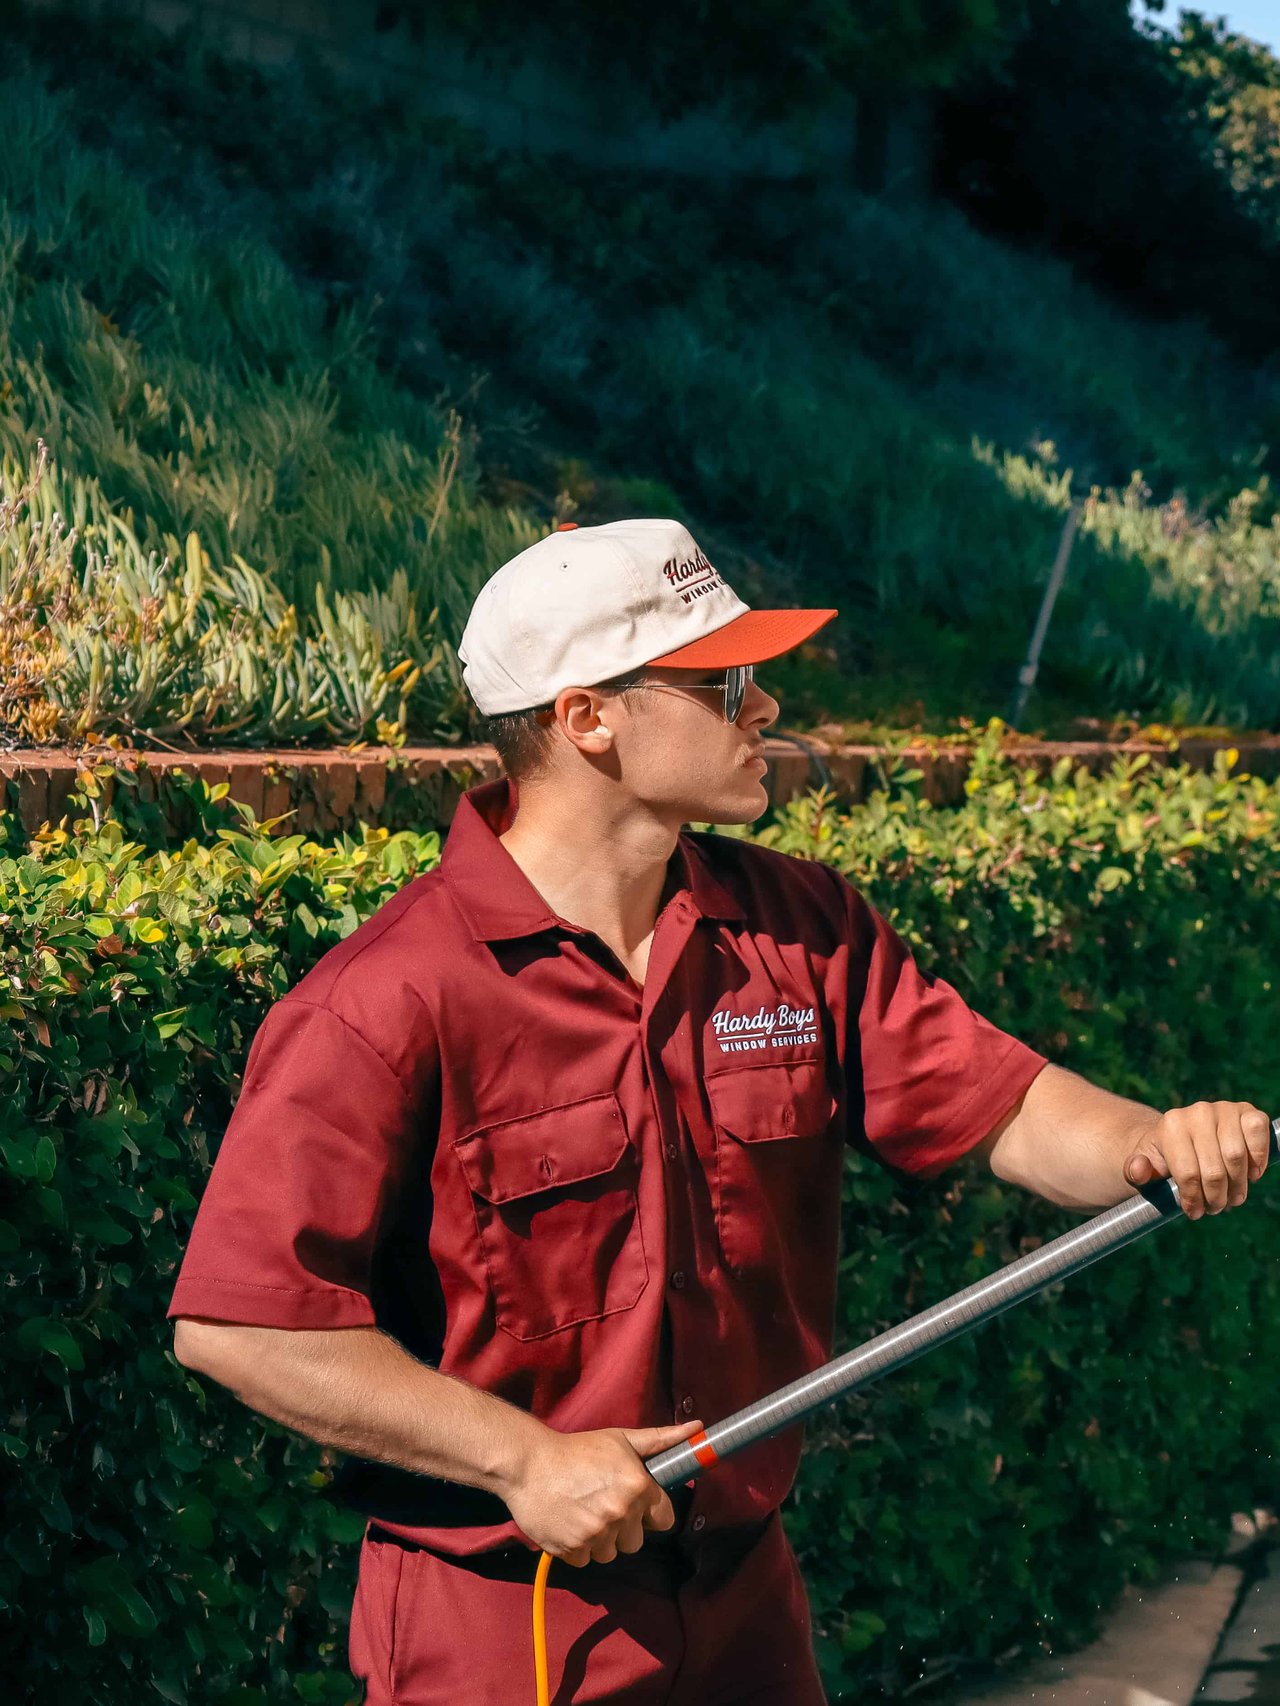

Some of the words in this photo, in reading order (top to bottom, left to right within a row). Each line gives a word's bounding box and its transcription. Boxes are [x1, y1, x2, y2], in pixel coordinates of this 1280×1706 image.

[663, 548, 713, 586] Hardy
[712, 1007, 777, 1034] Hardy
[777, 1004, 814, 1031] Boys
[720, 1039, 767, 1053] WINDOW
[771, 1033, 817, 1047] SERVICES
